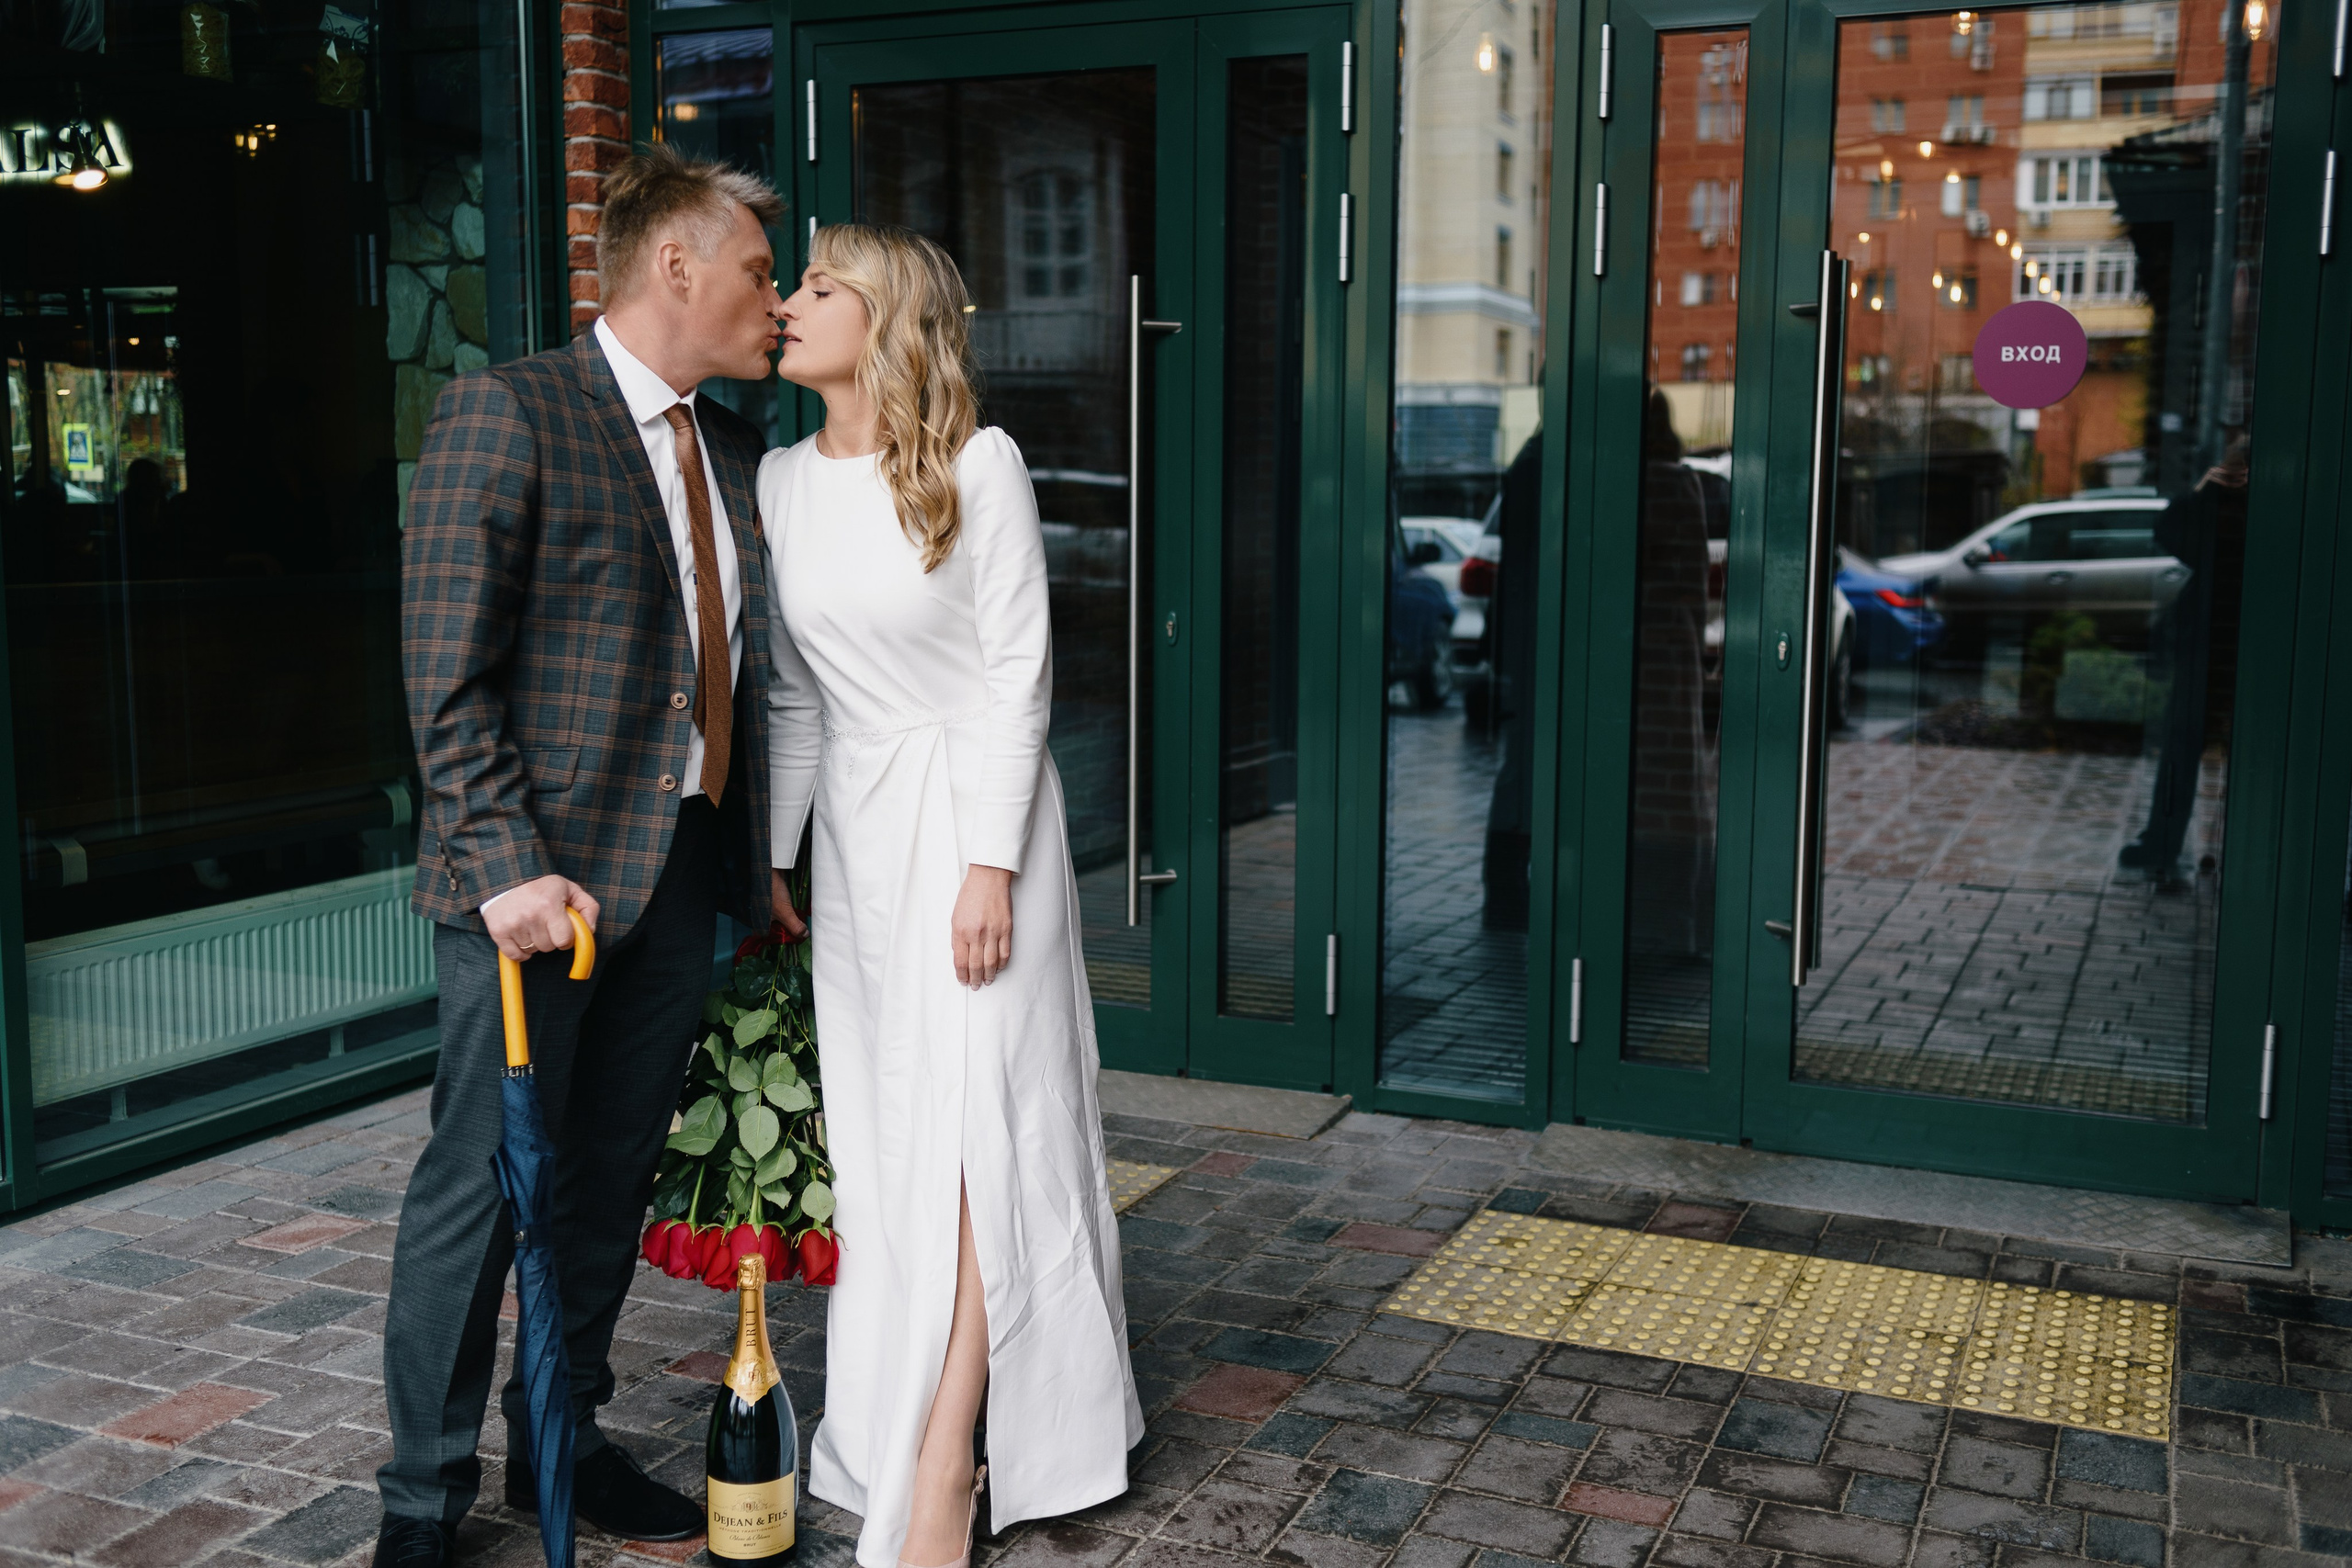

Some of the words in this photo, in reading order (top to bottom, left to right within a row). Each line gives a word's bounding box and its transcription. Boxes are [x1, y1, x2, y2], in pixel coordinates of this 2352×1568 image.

[0, 123, 124, 173] LSA
[2001, 345, 2061, 364] ВХОД
[745, 1308, 756, 1348] BRUT
[756, 1517, 764, 1526] &
